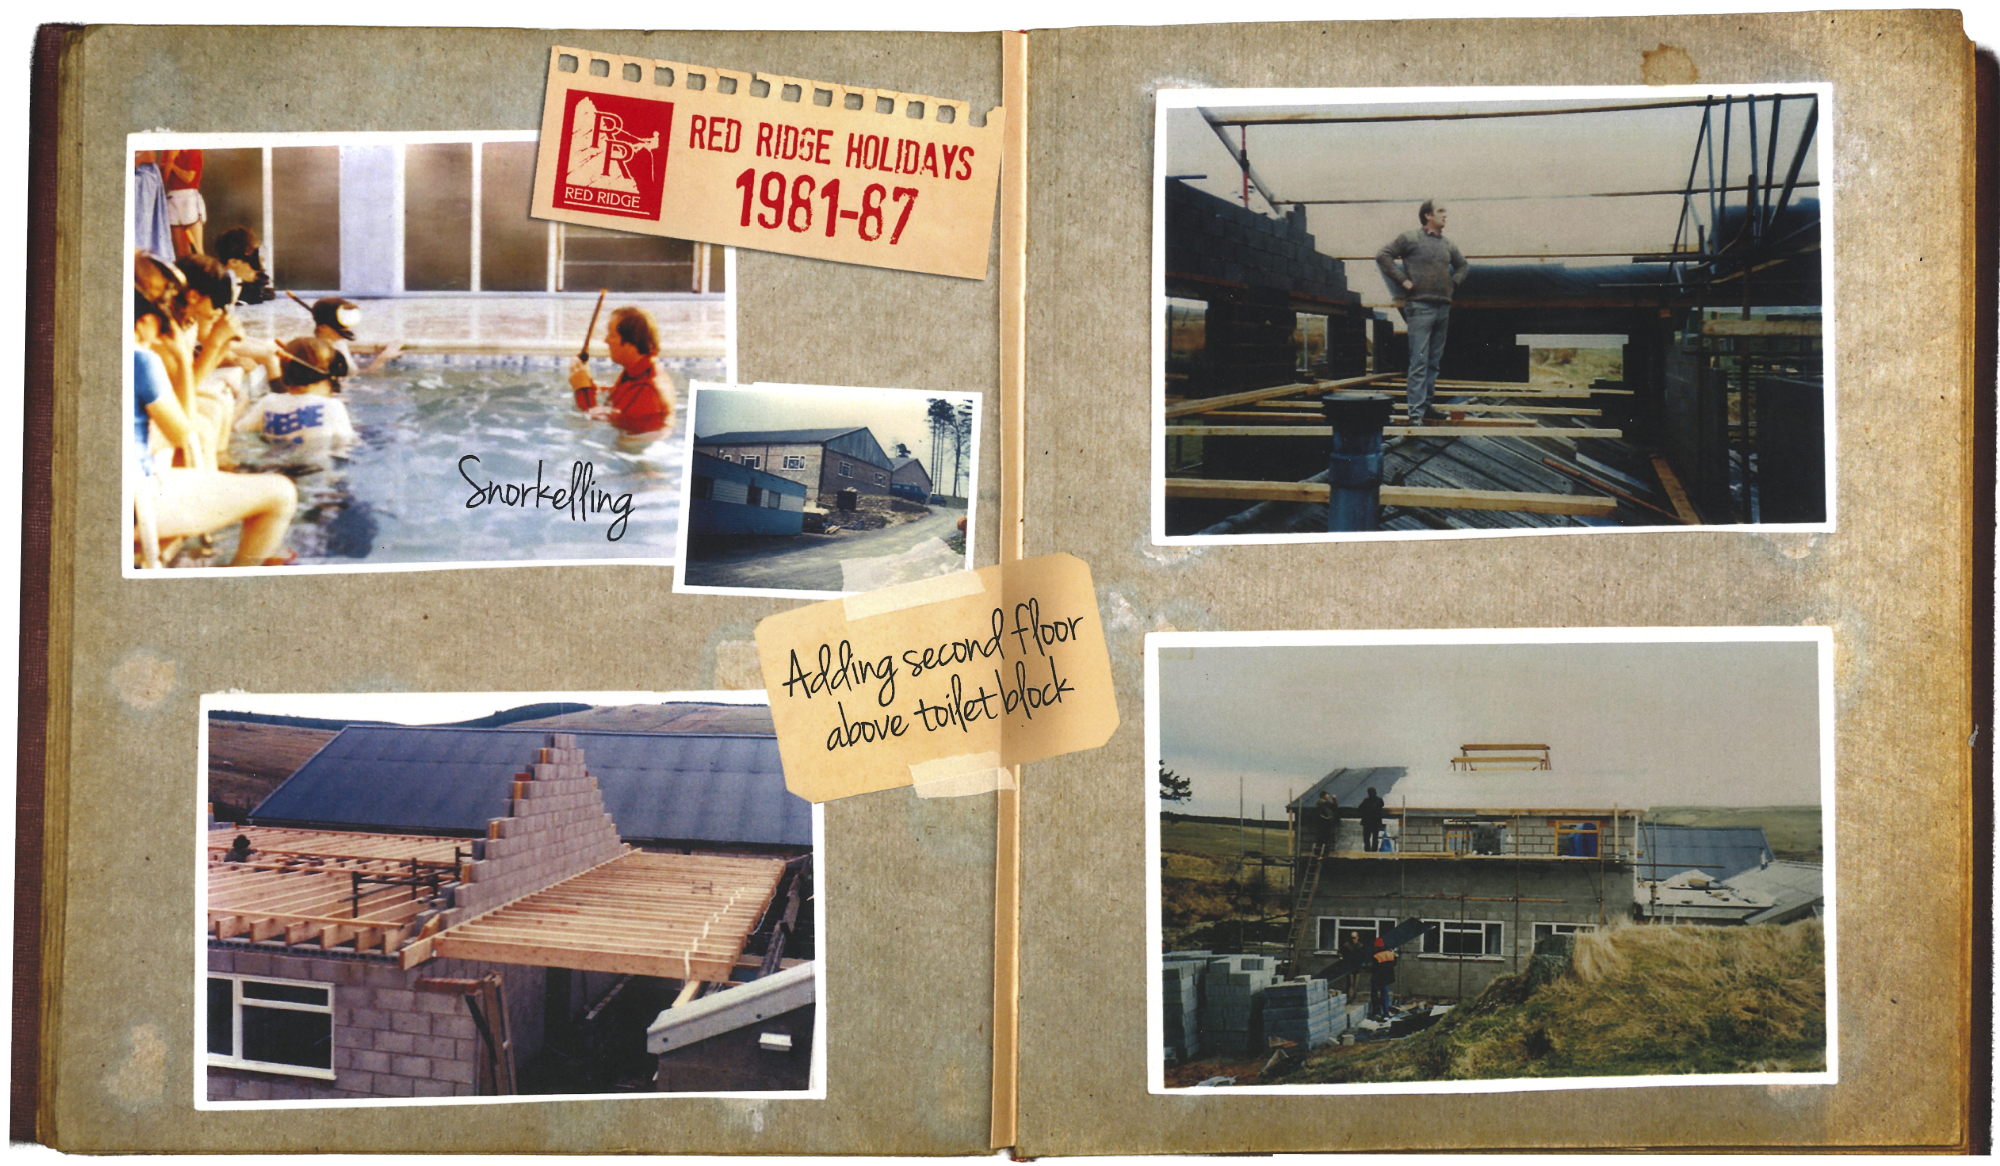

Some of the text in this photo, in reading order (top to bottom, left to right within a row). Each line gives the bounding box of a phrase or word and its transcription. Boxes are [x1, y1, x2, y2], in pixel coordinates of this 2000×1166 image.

[689, 114, 975, 181] RED RIDGE HOLIDAYS
[565, 186, 641, 209] RED RIDGE
[736, 168, 919, 245] 1981-87
[458, 454, 635, 542] Snorkelling
[782, 597, 1083, 707] Adding second floor
[826, 655, 1075, 751] above toilet block
